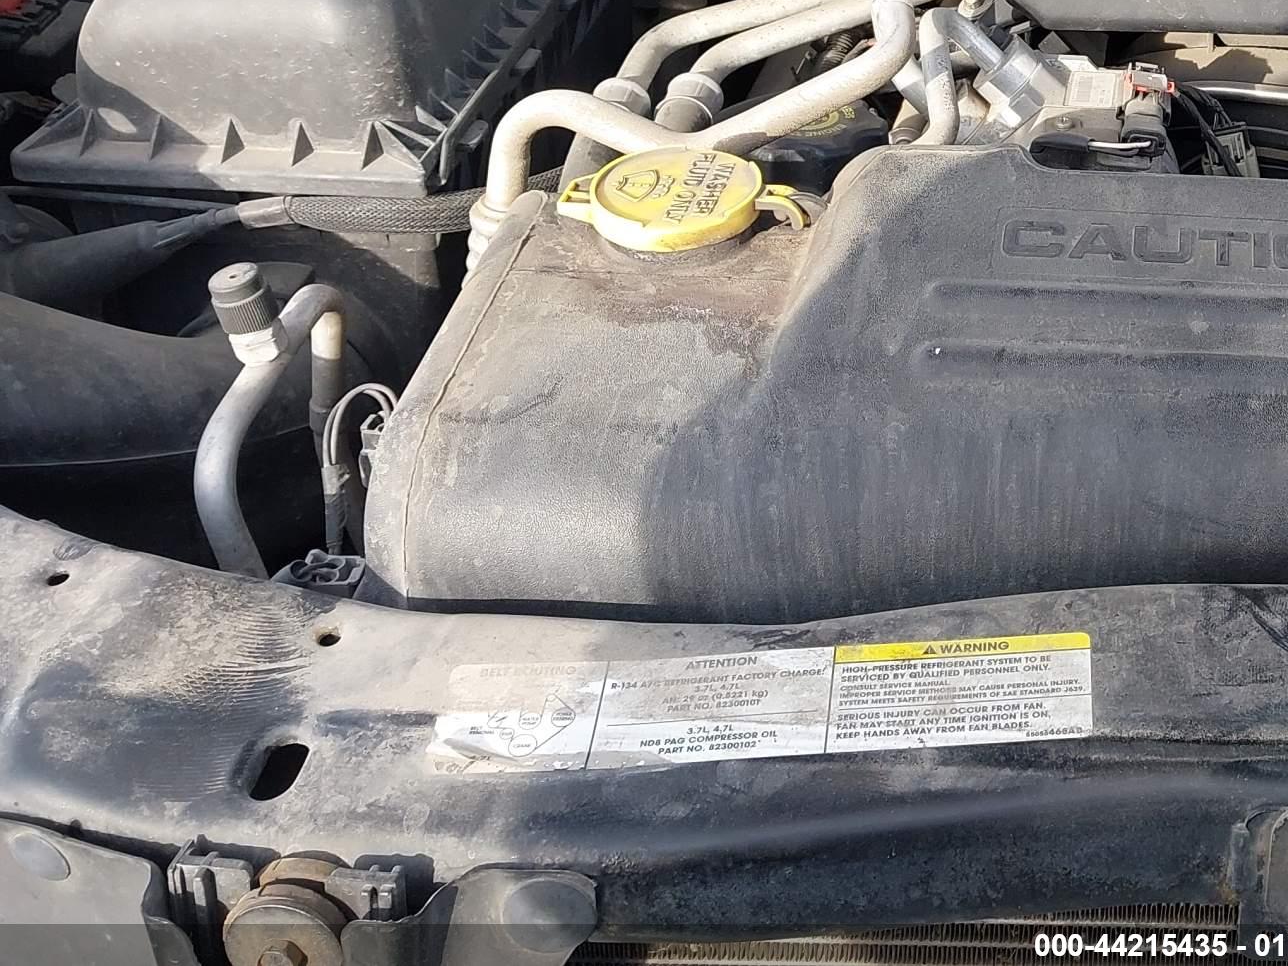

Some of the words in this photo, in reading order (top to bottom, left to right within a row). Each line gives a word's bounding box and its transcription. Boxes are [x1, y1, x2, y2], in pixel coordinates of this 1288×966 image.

[682, 152, 718, 187] FLUID
[693, 162, 736, 217] WASHER
[664, 190, 697, 225] ONLY
[940, 641, 1009, 654] WARNING
[685, 656, 758, 671] ATTENTION
[842, 663, 918, 674] HIGH-PRESSURE
[920, 659, 985, 670] REFRIGERANT
[987, 656, 1022, 666] SYSTEM
[1040, 655, 1052, 663] BE
[731, 671, 777, 682] FACTORY
[841, 674, 890, 683] SERVICED
[892, 672, 906, 680] BY
[909, 669, 960, 679] QUALIFIED
[963, 665, 1020, 676] PERSONNEL
[1023, 663, 1051, 672] ONLY.
[839, 690, 881, 699] IMPROPER
[959, 685, 977, 693] MAY
[978, 683, 1005, 691] CAUSE
[1006, 681, 1049, 690] PERSONAL
[840, 683, 878, 692] CONSULT
[880, 681, 912, 689] SERVICE
[839, 699, 869, 707] SYSTEM
[871, 697, 895, 705] MEETS
[897, 696, 925, 704] SAFETY
[989, 690, 1001, 698] OF
[1019, 687, 1062, 695] STANDARD
[667, 704, 691, 713] PART
[837, 711, 881, 722] SERIOUS
[883, 709, 921, 719] INJURY
[923, 707, 950, 716] CAN
[950, 705, 989, 715] OCCUR
[991, 703, 1020, 712] FROM
[836, 722, 859, 731] FAN
[860, 720, 882, 729] MAY
[885, 719, 916, 727] START
[919, 717, 941, 725] ANY
[944, 716, 967, 724] TIME
[969, 712, 1017, 723] IGNITION
[1020, 711, 1029, 719] IS
[664, 737, 686, 745] PAG
[688, 732, 758, 743] COMPRESSOR
[761, 730, 778, 738] OIL
[836, 732, 861, 740] KEEP
[863, 728, 900, 738] HANDS
[903, 726, 932, 736] AWAY
[936, 725, 966, 734] FROM
[968, 723, 989, 732] FAN
[658, 746, 683, 755] PART
[686, 744, 706, 752] NO.
